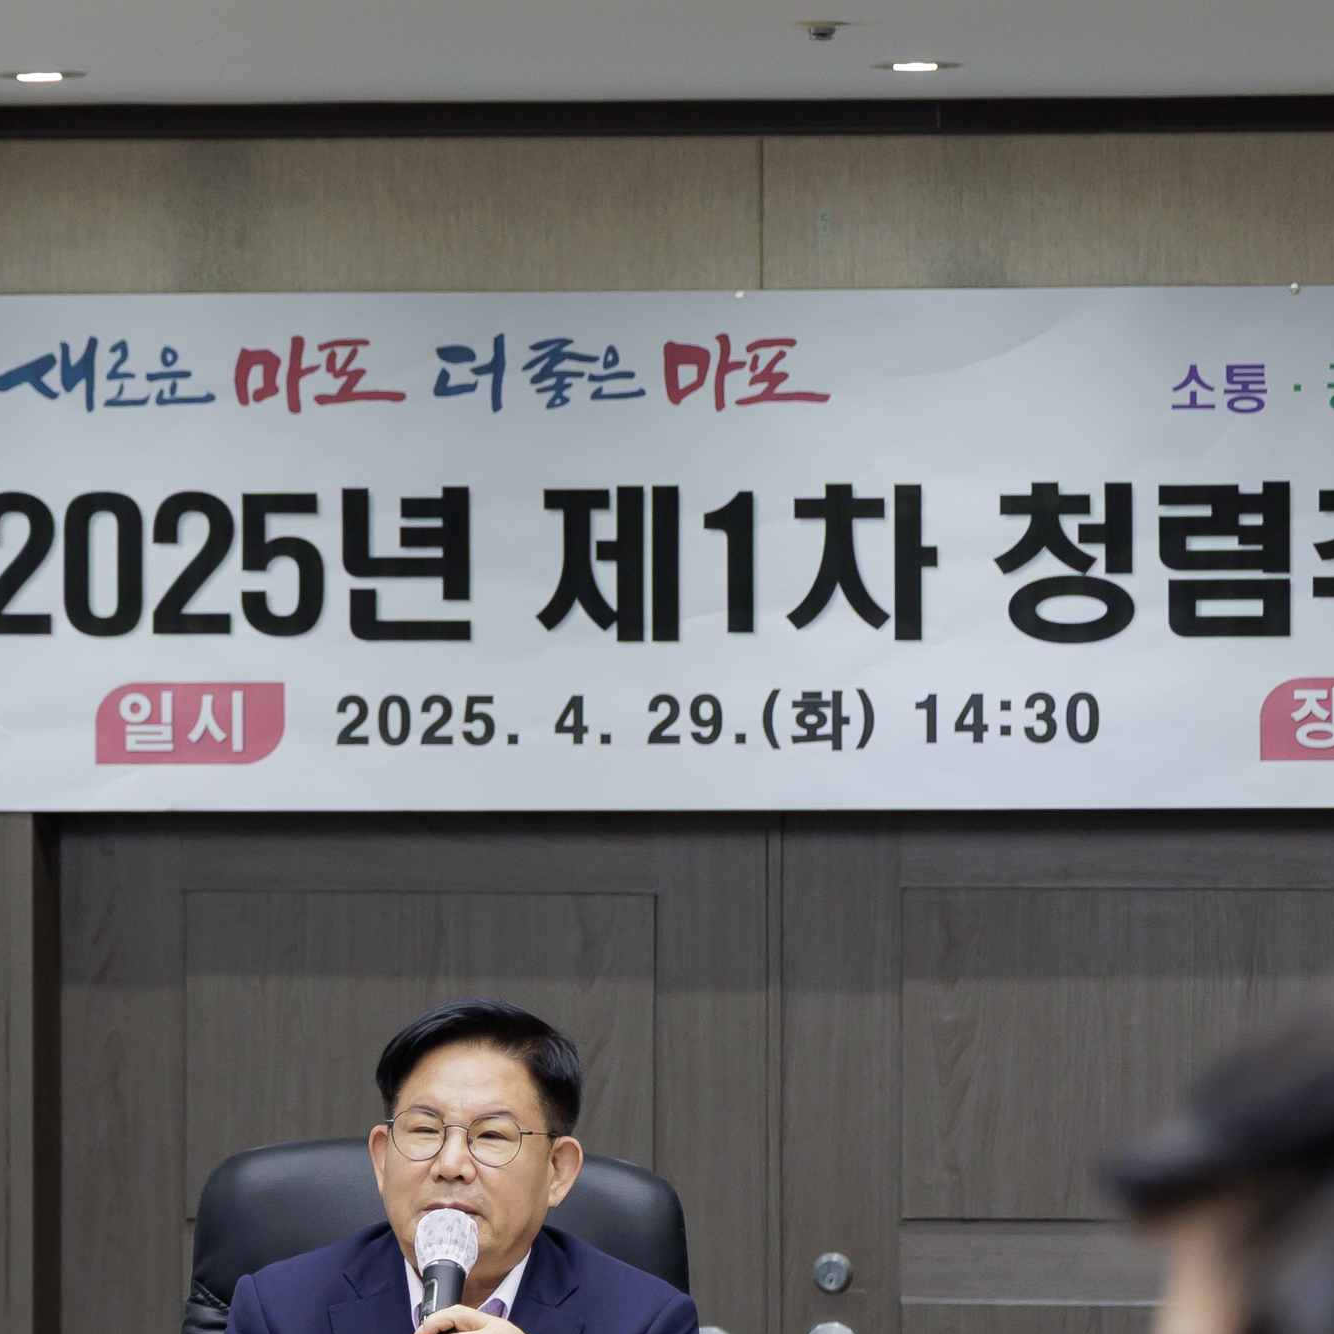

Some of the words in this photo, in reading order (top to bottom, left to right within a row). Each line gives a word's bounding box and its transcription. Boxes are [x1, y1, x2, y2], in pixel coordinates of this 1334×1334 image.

[234, 336, 407, 415] 마포
[433, 333, 509, 414] 더
[522, 336, 648, 410] 좋은
[663, 333, 832, 414] 마포
[1171, 363, 1269, 414] 소통
[536, 480, 940, 645] 제1차
[118, 689, 246, 753] 일시
[336, 694, 522, 747] 2025.
[555, 695, 615, 747] 4.
[647, 689, 877, 752] 29.(화)
[914, 692, 1102, 746] 14:30
